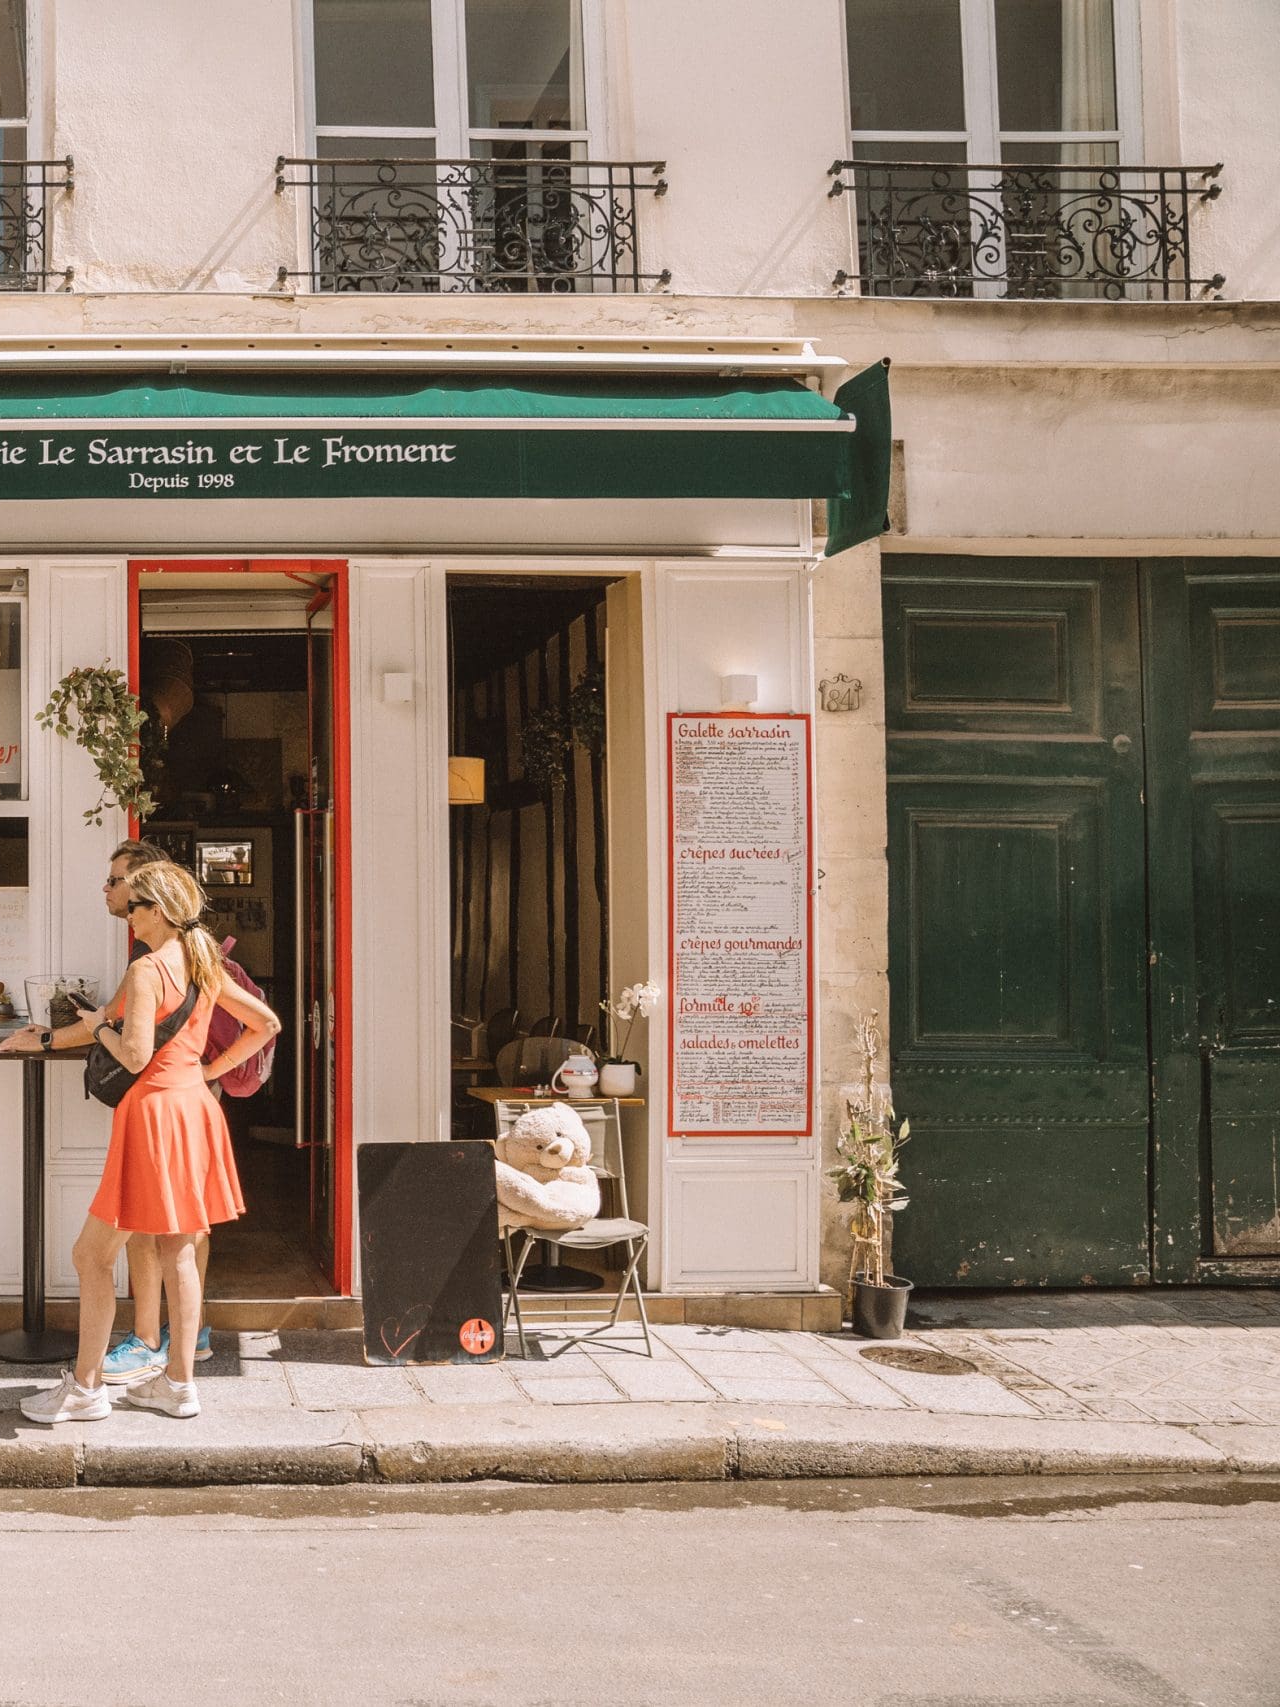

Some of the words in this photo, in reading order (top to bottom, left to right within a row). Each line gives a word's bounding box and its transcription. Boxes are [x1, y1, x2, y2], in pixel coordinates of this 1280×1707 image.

[38, 439, 76, 466] Le
[88, 438, 217, 465] Sarrasin
[229, 444, 263, 464] et
[273, 437, 311, 465] Le
[321, 435, 457, 468] Froment
[128, 472, 189, 493] Depuis
[197, 473, 235, 489] 1998
[826, 687, 854, 712] 84
[678, 722, 724, 738] Galette
[728, 724, 791, 739] sarrasin
[680, 845, 725, 864] crêpes
[729, 845, 780, 859] sucrées
[680, 936, 721, 954] crêpes
[724, 936, 803, 953] gourmandes
[680, 994, 735, 1014] formule
[680, 1034, 730, 1049] salades
[738, 1034, 800, 1049] omelettes
